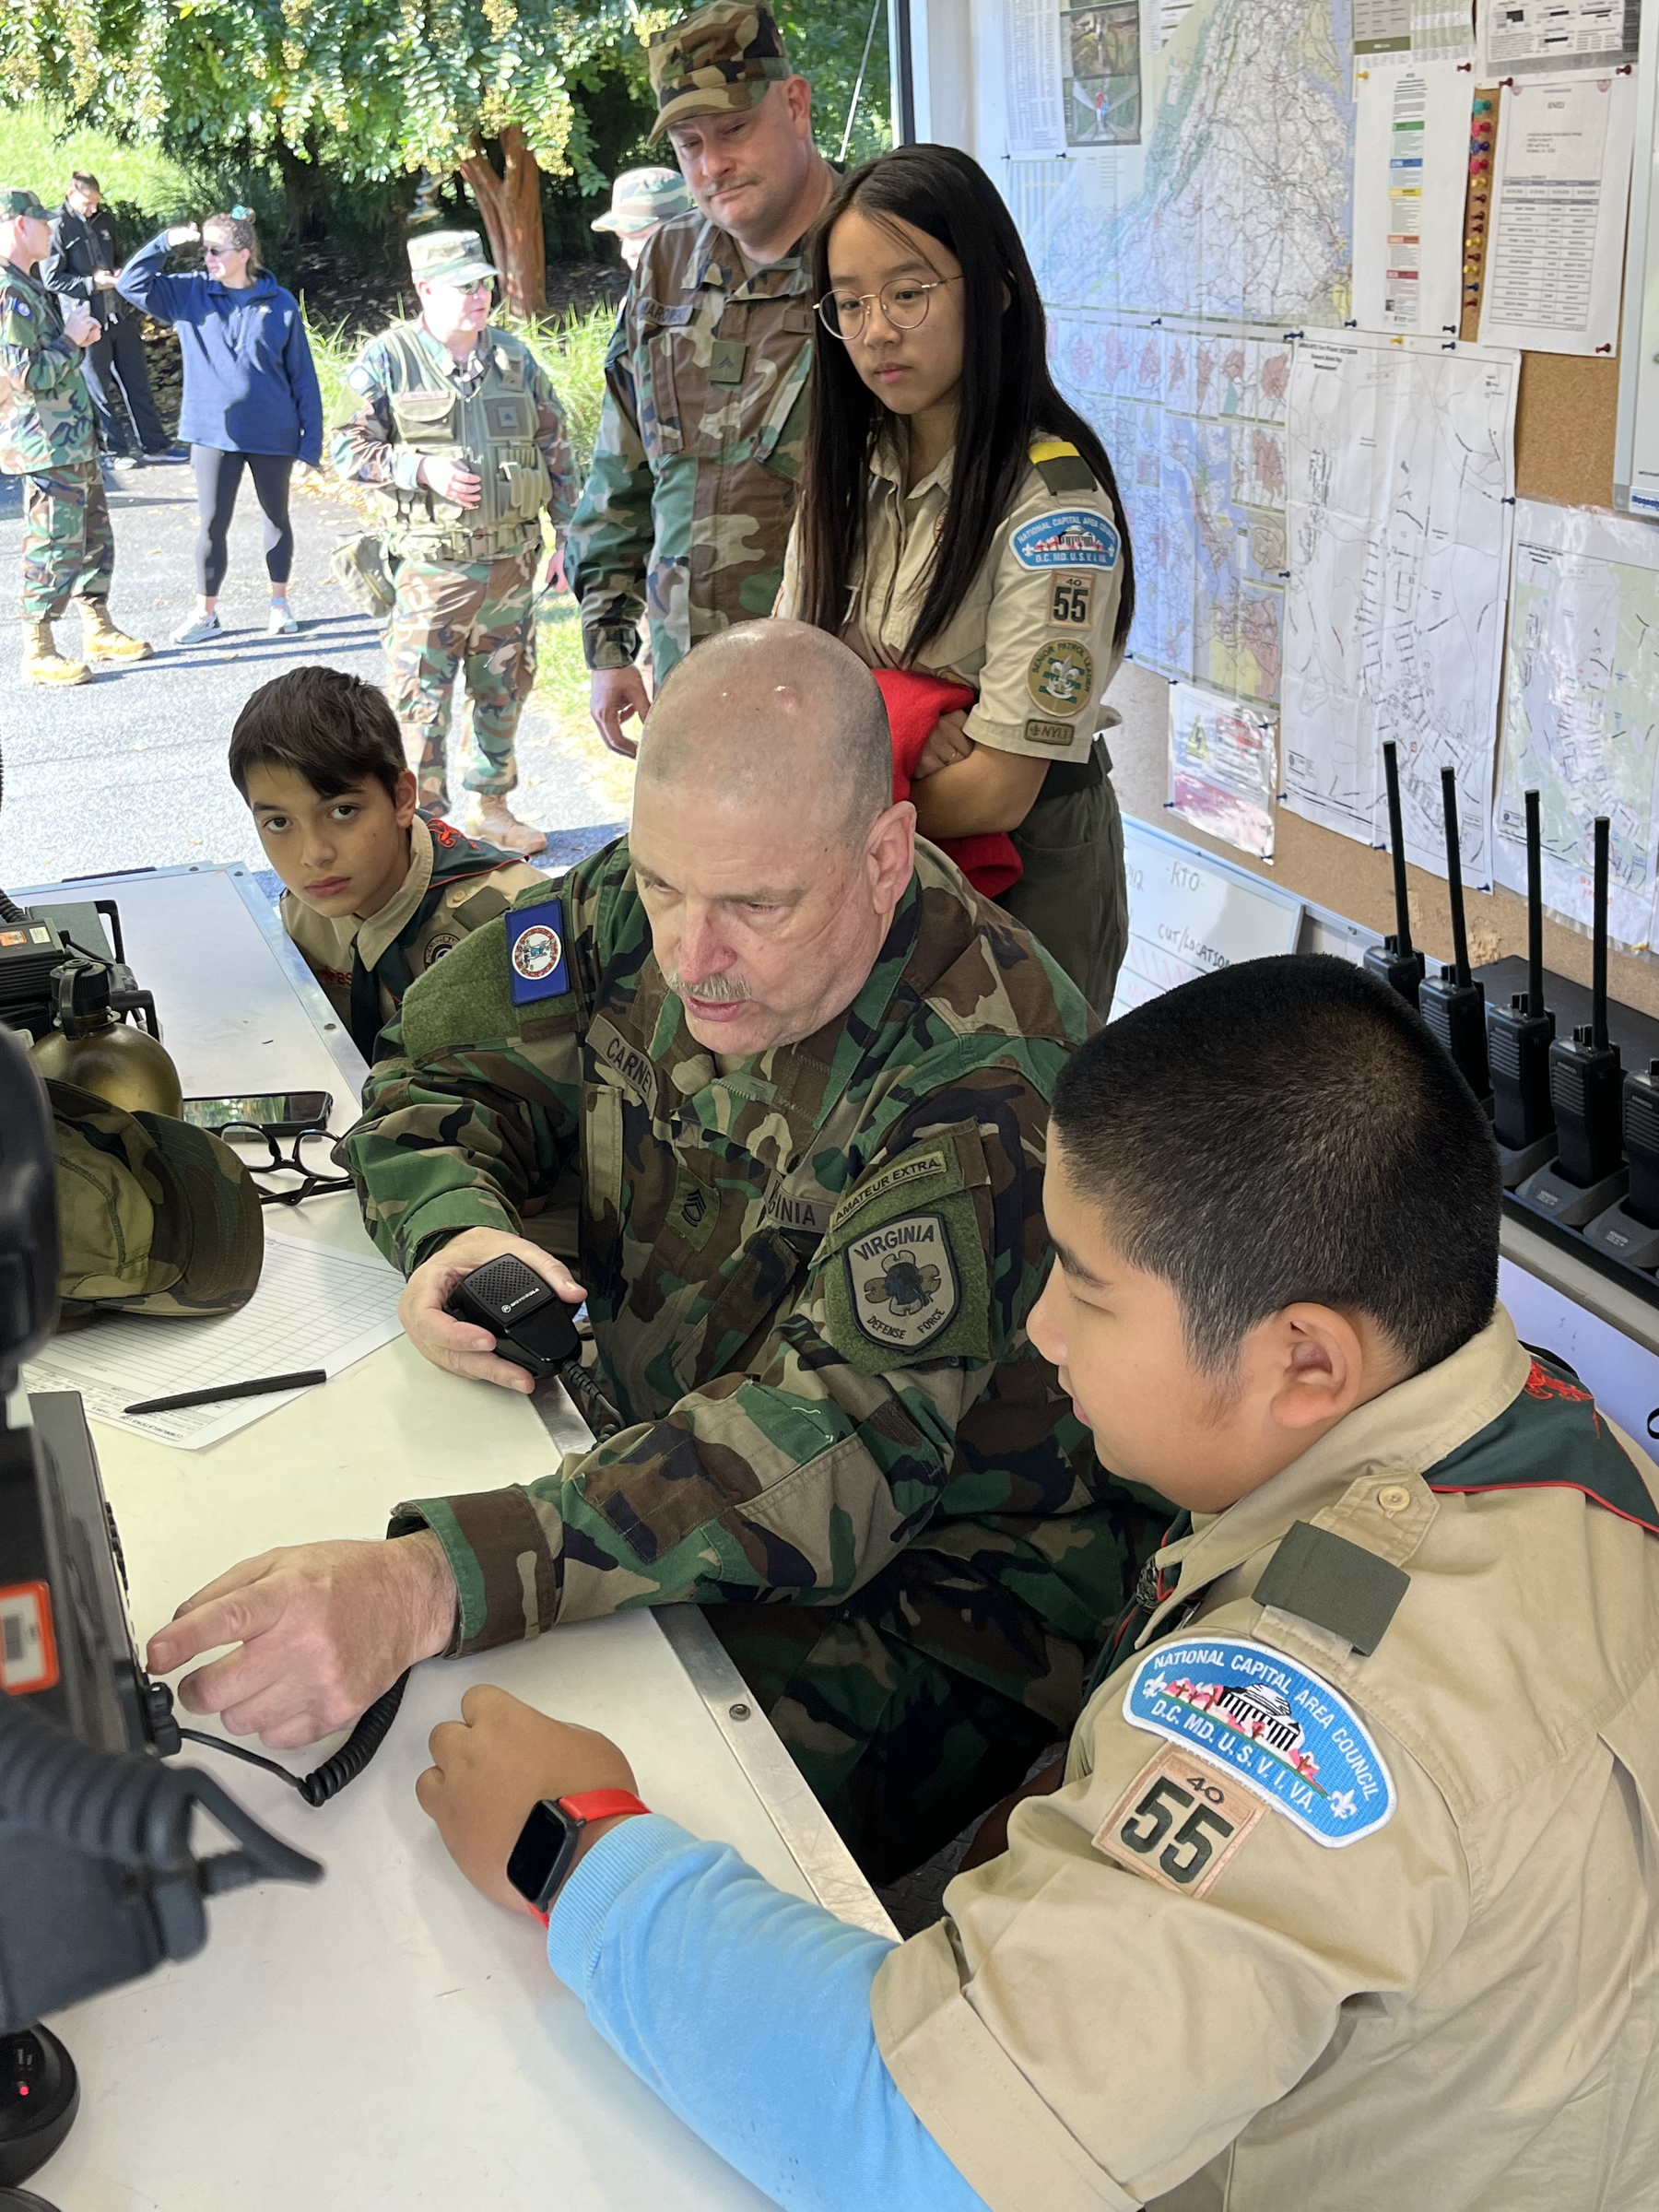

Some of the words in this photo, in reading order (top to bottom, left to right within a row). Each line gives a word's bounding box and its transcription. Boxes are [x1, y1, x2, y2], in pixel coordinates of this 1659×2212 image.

[1017, 522, 1052, 544] NATIONAL
[1053, 516, 1081, 526] CAPITAL
[1082, 517, 1099, 528] AREA
[1035, 554, 1051, 563] D.C.
[1065, 578, 1082, 586] 40
[1053, 586, 1088, 623] 55
[1031, 645, 1055, 674] SENIOR
[1057, 642, 1085, 658] PATROL
[1083, 656, 1092, 692] LEADER
[1041, 724, 1069, 740] NYLT
[835, 1176, 890, 1223] AMATEUR
[892, 1158, 942, 1181] EXTRA
[853, 1224, 935, 1262] VIRGINIA
[510, 1288, 540, 1308] MOTOROLA
[866, 1315, 907, 1340] DEFENSE
[917, 1308, 946, 1334] FORCE
[1154, 1650, 1225, 1670] NATIONAL
[1230, 1654, 1292, 1695] CAPITAL
[1294, 1688, 1335, 1730] AREA
[1332, 1727, 1380, 1802] COUNCIL
[1151, 1699, 1182, 1725] D.C.
[1182, 1712, 1215, 1744] MD.
[1290, 1780, 1316, 1814] VA.
[1186, 1777, 1226, 1805] 40
[1121, 1775, 1235, 1884] 55
